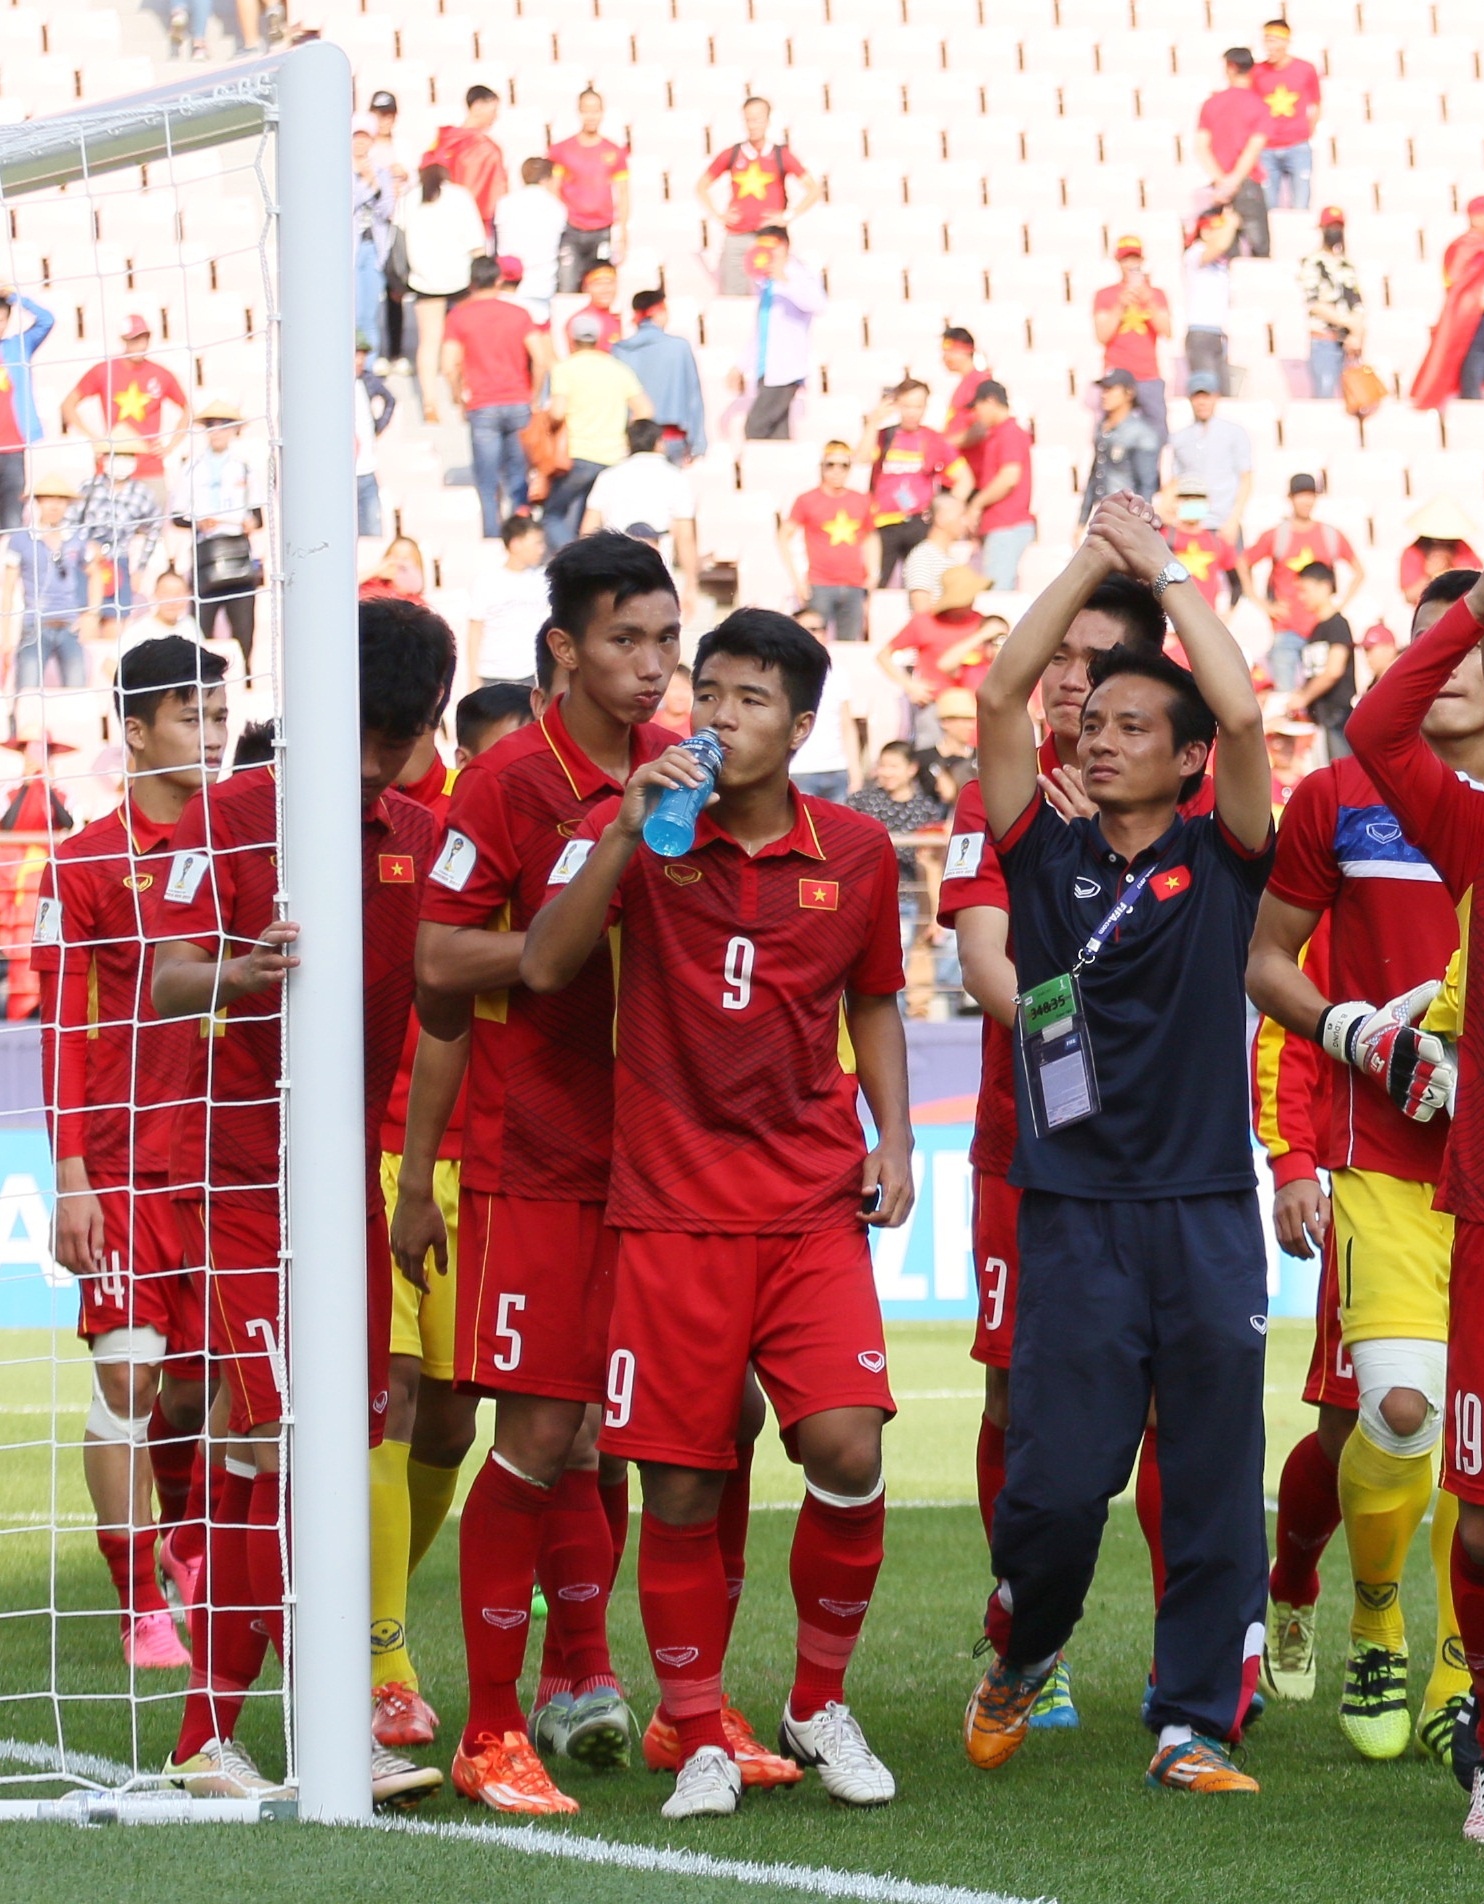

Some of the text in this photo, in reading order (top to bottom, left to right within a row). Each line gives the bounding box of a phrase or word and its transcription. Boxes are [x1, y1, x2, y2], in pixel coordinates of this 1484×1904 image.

[722, 936, 756, 1010] 9
[1030, 994, 1066, 1021] 34&35
[93, 1250, 125, 1309] 14
[985, 1257, 1008, 1330] 3
[245, 1318, 284, 1393] 7
[493, 1293, 526, 1371] 5
[604, 1348, 636, 1428] 9
[1454, 1389, 1483, 1476] 19
